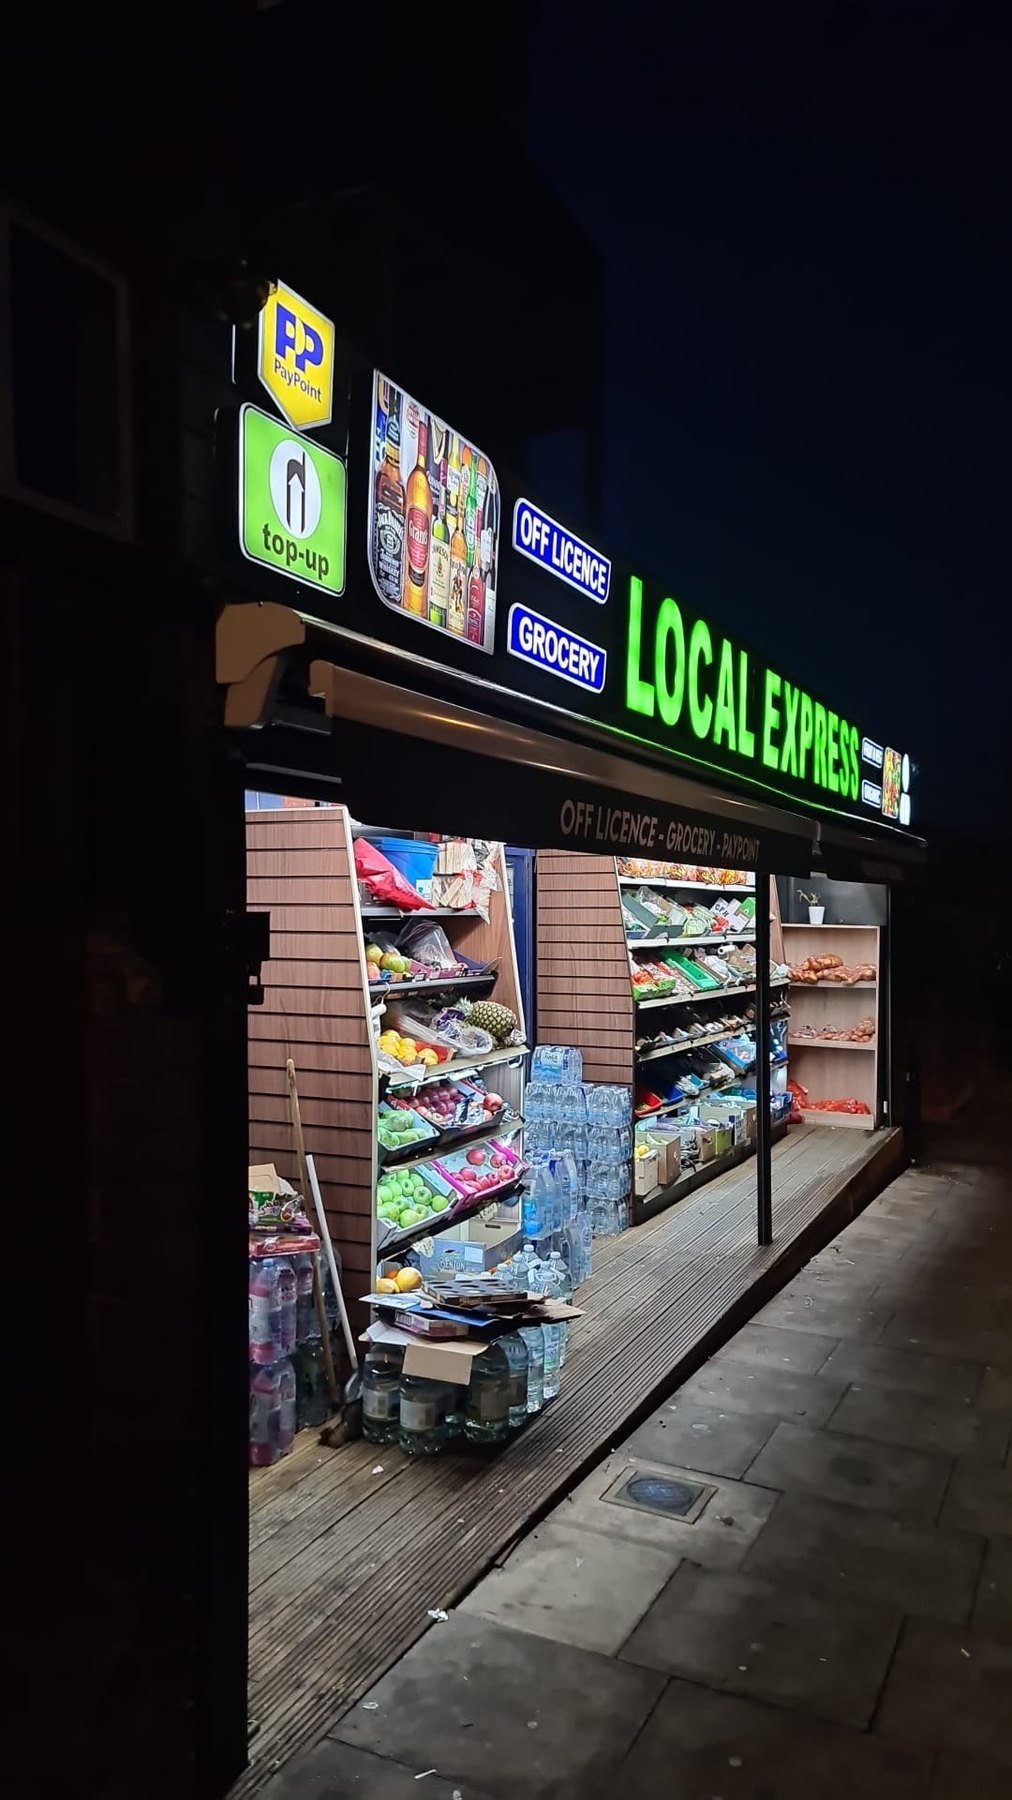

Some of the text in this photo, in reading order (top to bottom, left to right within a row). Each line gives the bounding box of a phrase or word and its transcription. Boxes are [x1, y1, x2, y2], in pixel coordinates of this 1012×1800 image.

[274, 358, 322, 403] PayPoint
[262, 523, 330, 577] top-up
[520, 510, 550, 556] OFF
[552, 531, 607, 596] LICENCE
[518, 616, 600, 682] GROCERY
[626, 575, 860, 801] LOCAL EXPRESS
[560, 799, 594, 838] OFF
[596, 806, 658, 848] LICENCE
[666, 821, 715, 855] GROCERY
[721, 832, 760, 862] PAYPOINT
